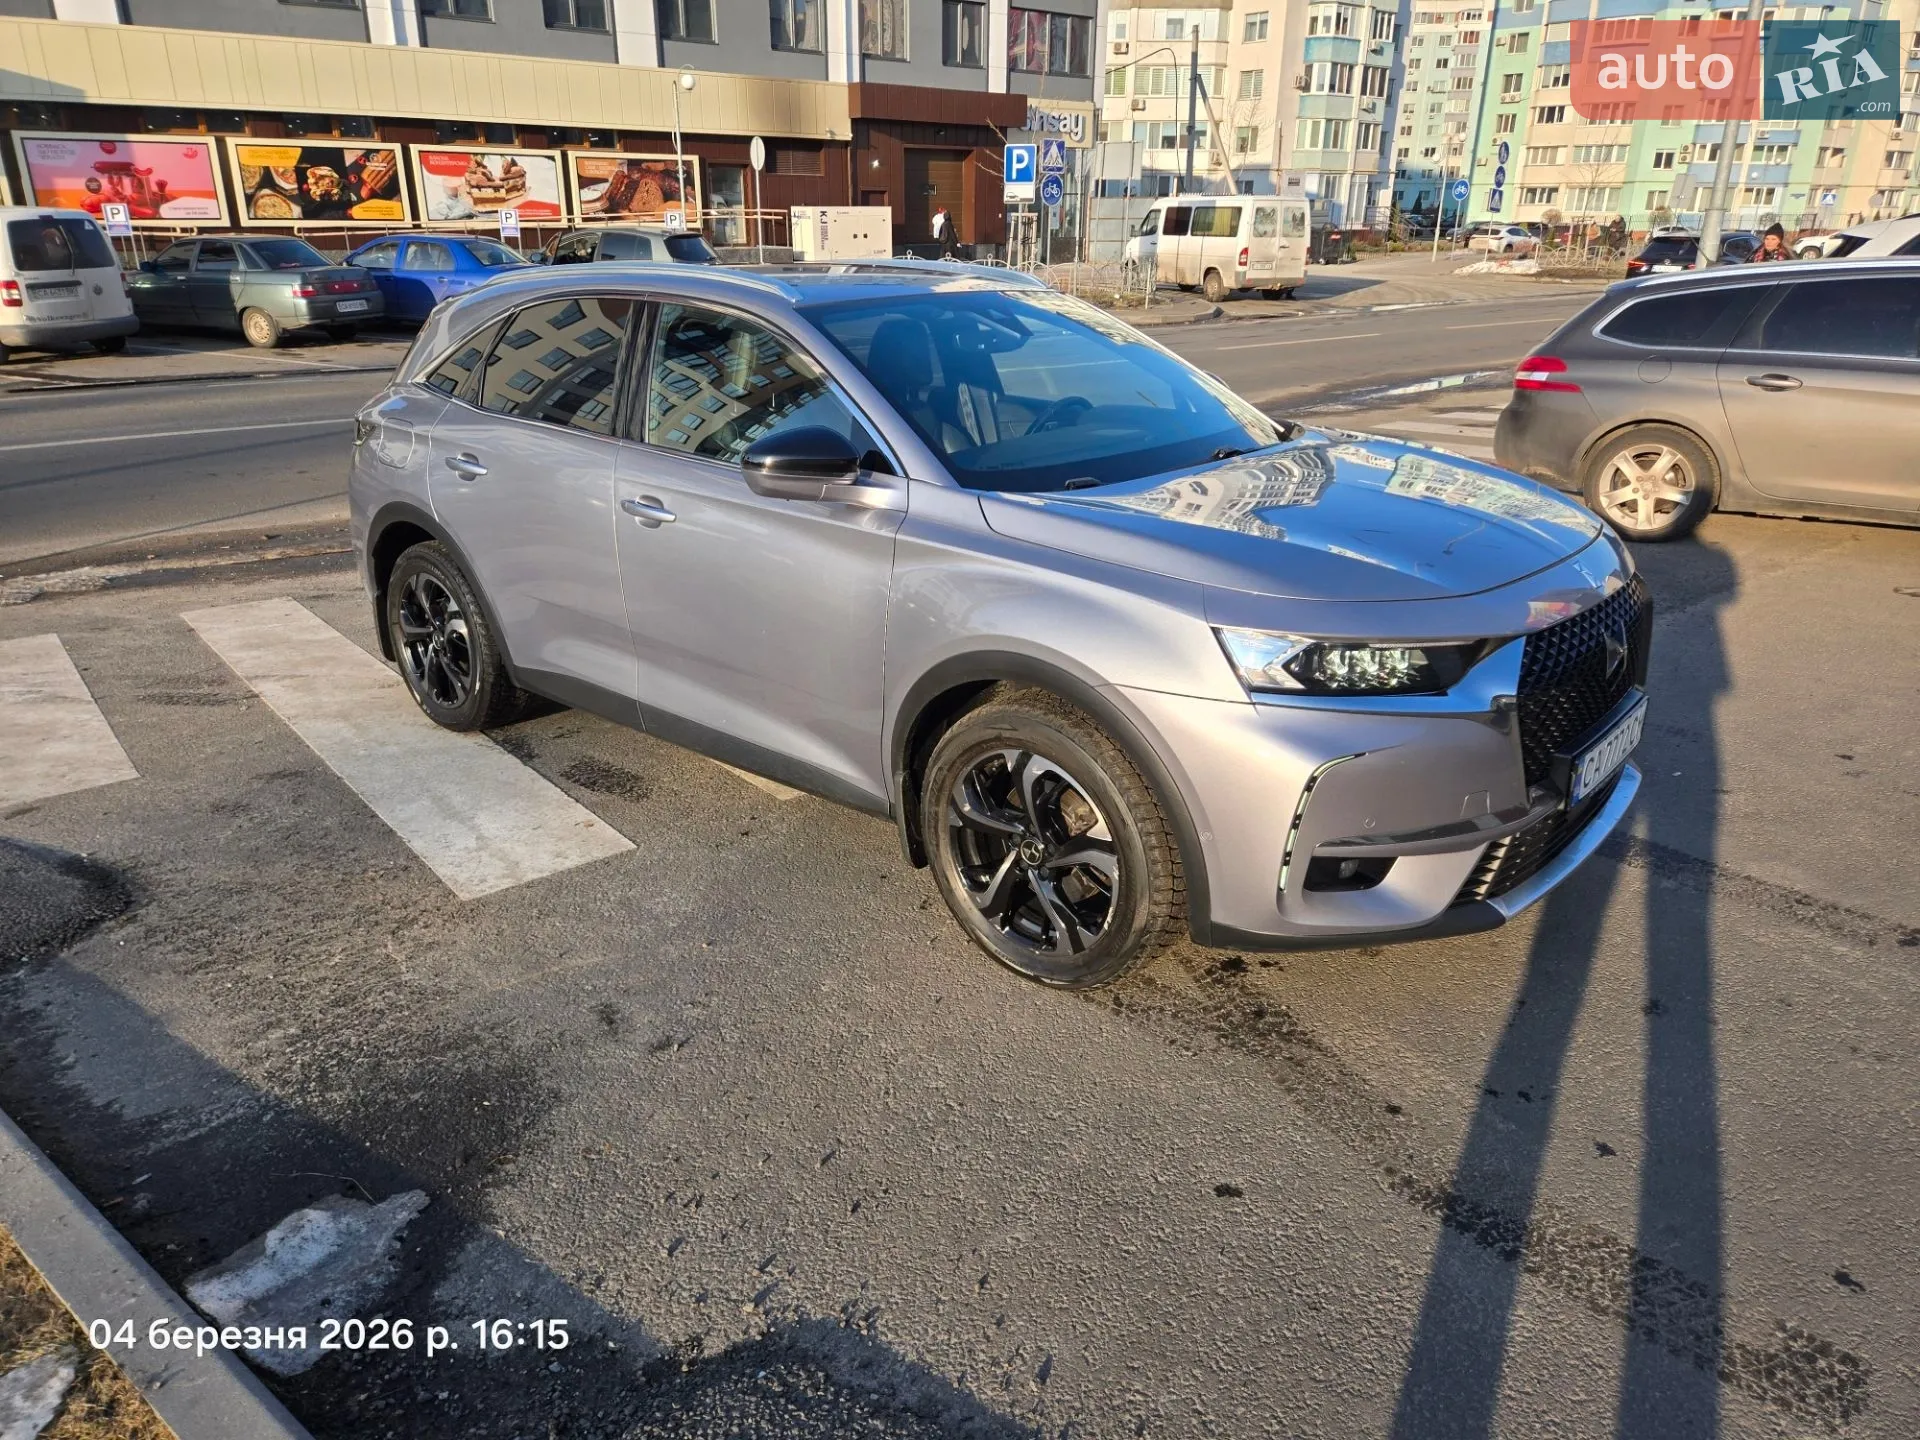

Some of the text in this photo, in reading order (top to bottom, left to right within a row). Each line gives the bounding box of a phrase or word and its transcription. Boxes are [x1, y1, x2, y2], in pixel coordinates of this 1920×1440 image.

[1011, 149, 1029, 180] P
[110, 206, 121, 220] P
[504, 212, 513, 223] P
[669, 214, 677, 225] P
